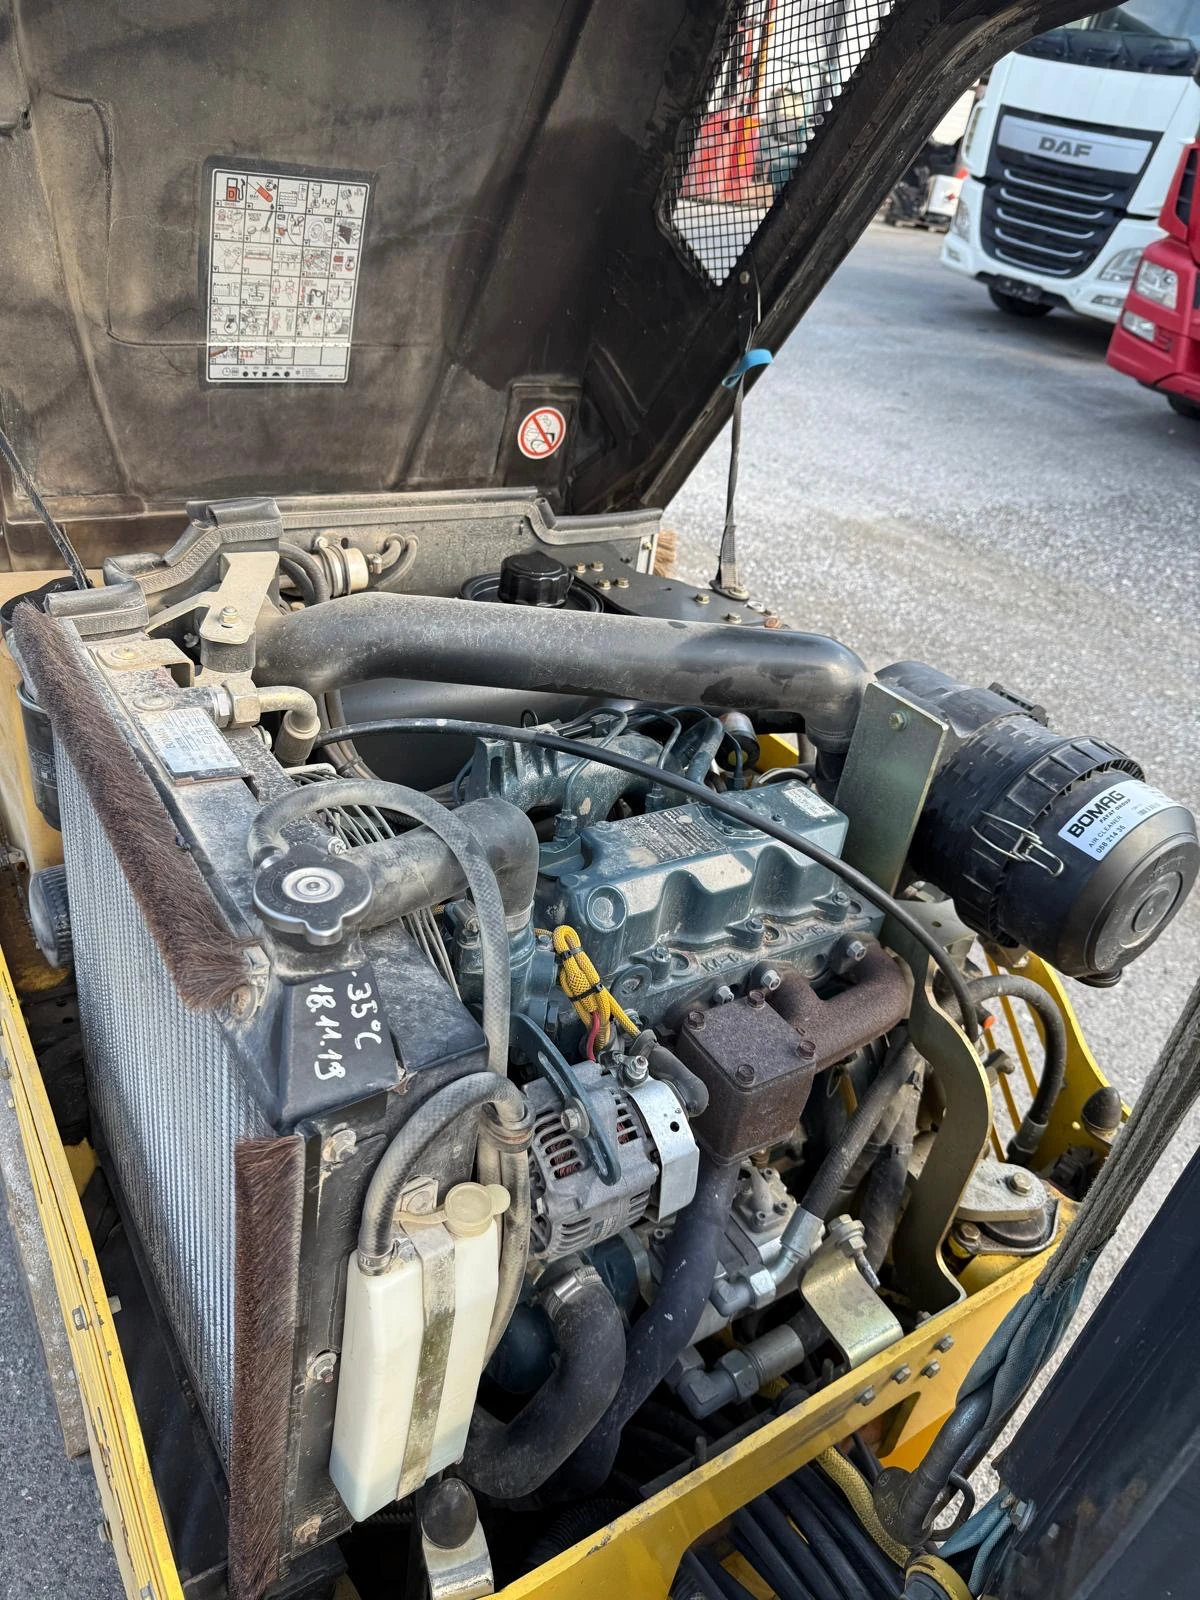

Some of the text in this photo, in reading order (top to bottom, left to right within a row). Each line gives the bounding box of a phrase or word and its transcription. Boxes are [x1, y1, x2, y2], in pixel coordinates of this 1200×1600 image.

[1039, 137, 1092, 157] DAF
[1067, 790, 1126, 838] BOMAG
[1100, 808, 1115, 824] FAYAT
[1088, 815, 1123, 849] AIR CLEANER
[1107, 831, 1118, 843] 214
